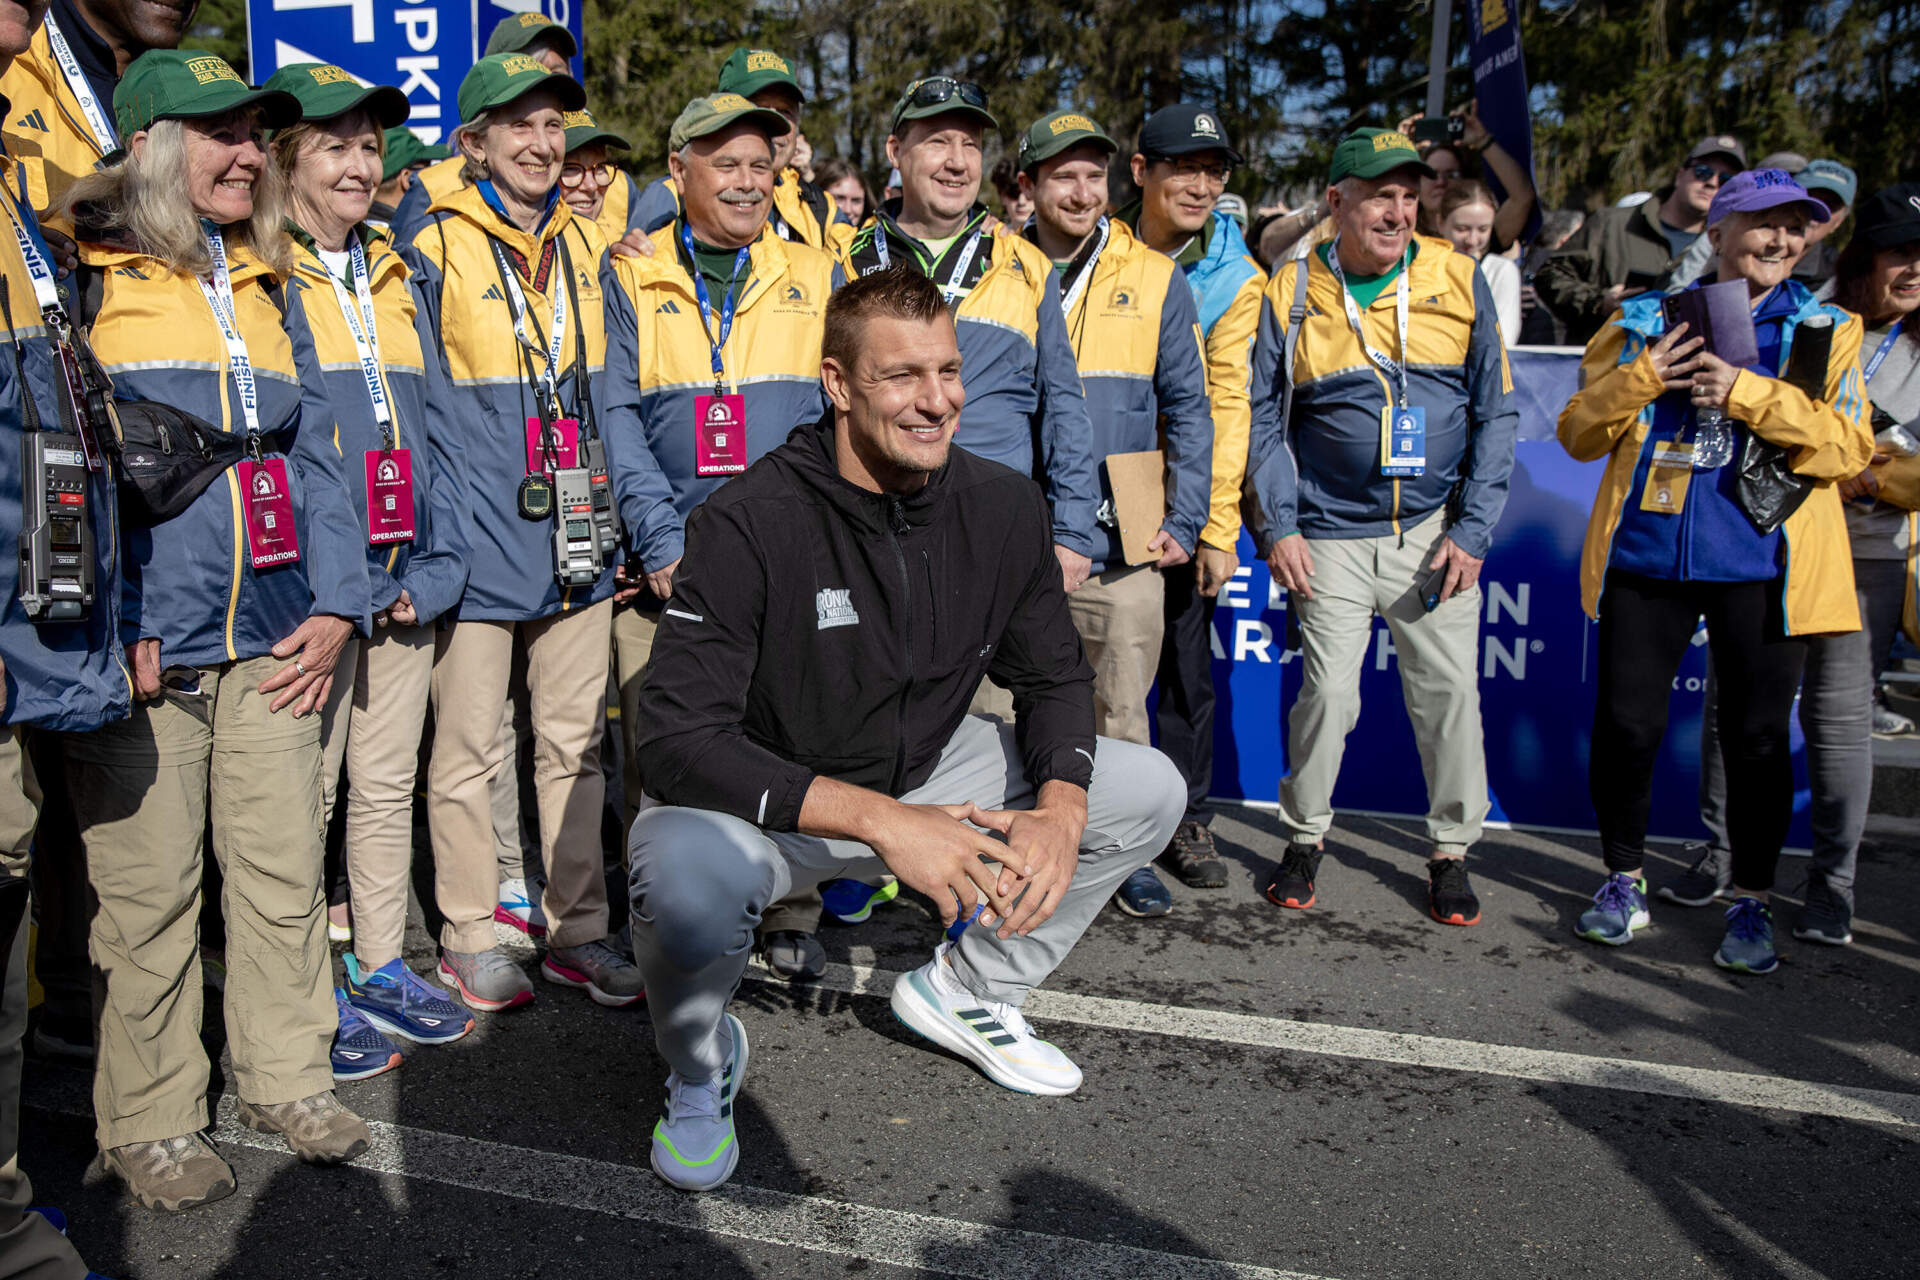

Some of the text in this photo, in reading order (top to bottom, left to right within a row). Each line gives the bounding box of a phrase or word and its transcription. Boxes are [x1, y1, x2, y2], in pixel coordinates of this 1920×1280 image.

[351, 241, 366, 278] FINISH
[240, 355, 256, 409] FINISH
[362, 356, 384, 405] FINISH
[699, 464, 745, 473] OPERATIONS
[371, 530, 413, 541] OPERATIONS
[254, 550, 298, 565] OPERATIONS
